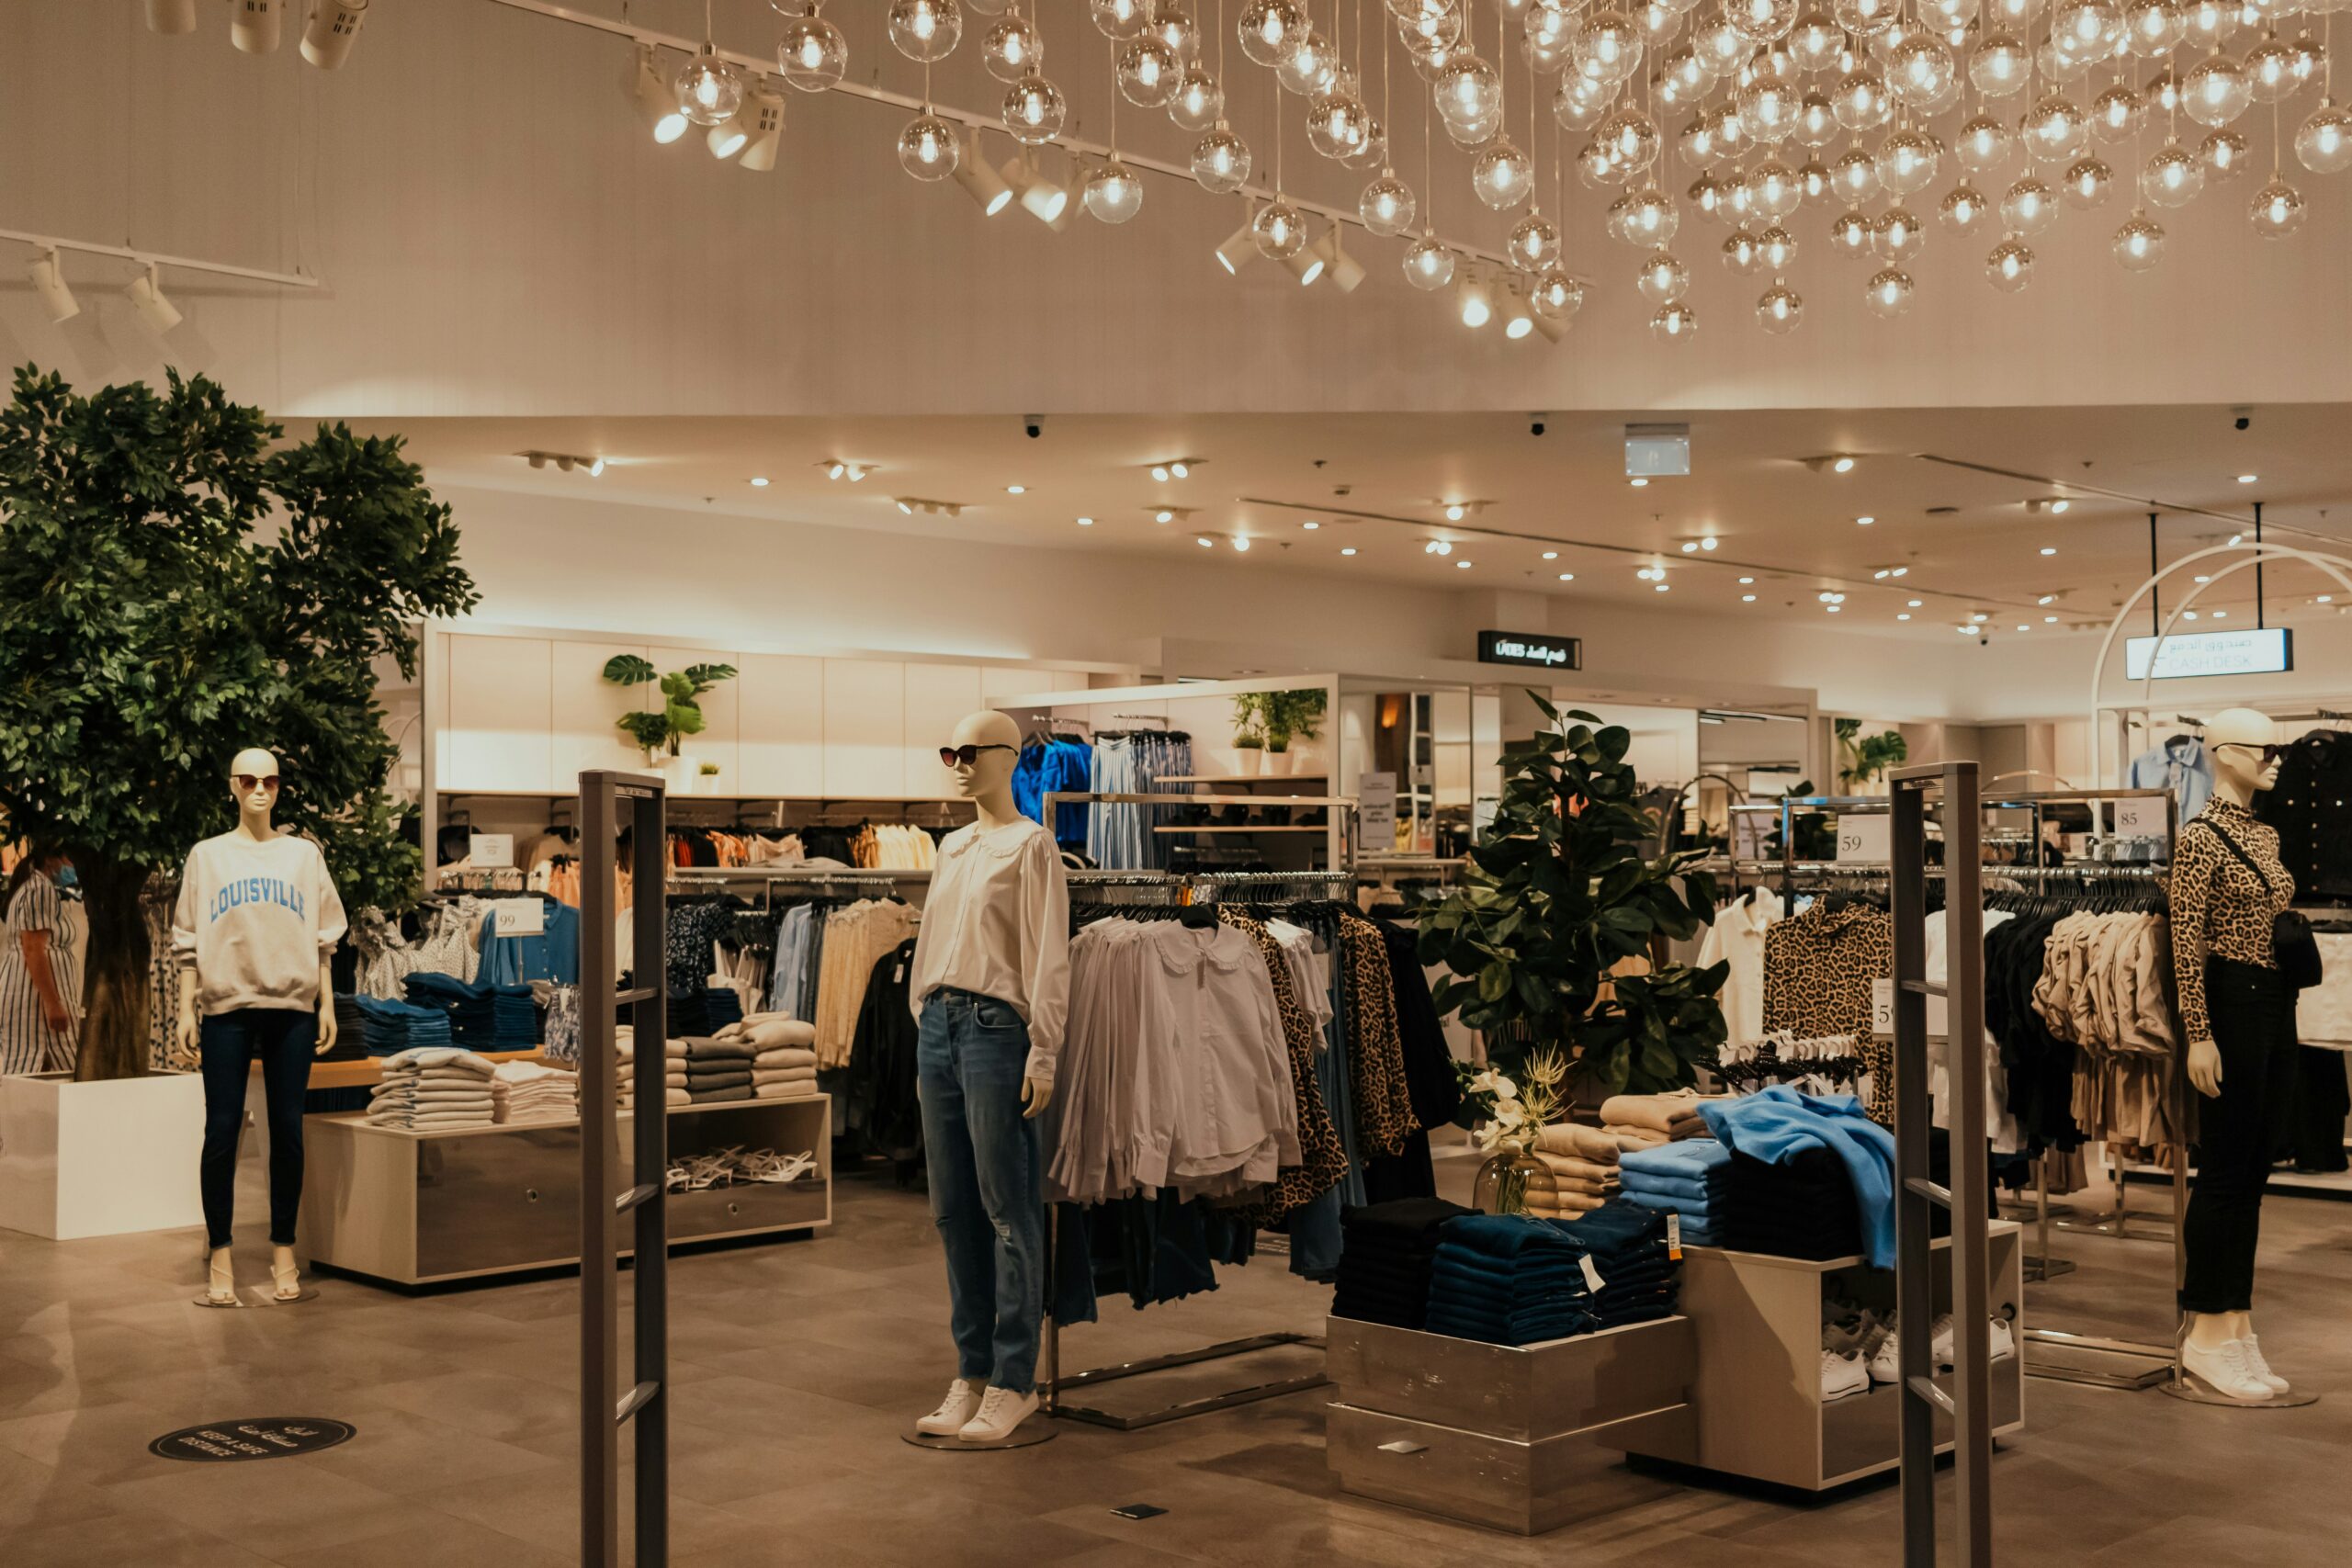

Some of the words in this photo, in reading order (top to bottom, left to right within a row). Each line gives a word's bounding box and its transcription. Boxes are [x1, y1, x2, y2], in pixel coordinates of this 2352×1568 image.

[2169, 657, 2210, 671] CASH
[2213, 654, 2251, 669] DESK
[2120, 812, 2138, 826] 85
[1841, 835, 1861, 852] 59
[210, 877, 305, 924] LOUISVILLE
[499, 914, 515, 927] 99
[1878, 1005, 1894, 1024] 5
